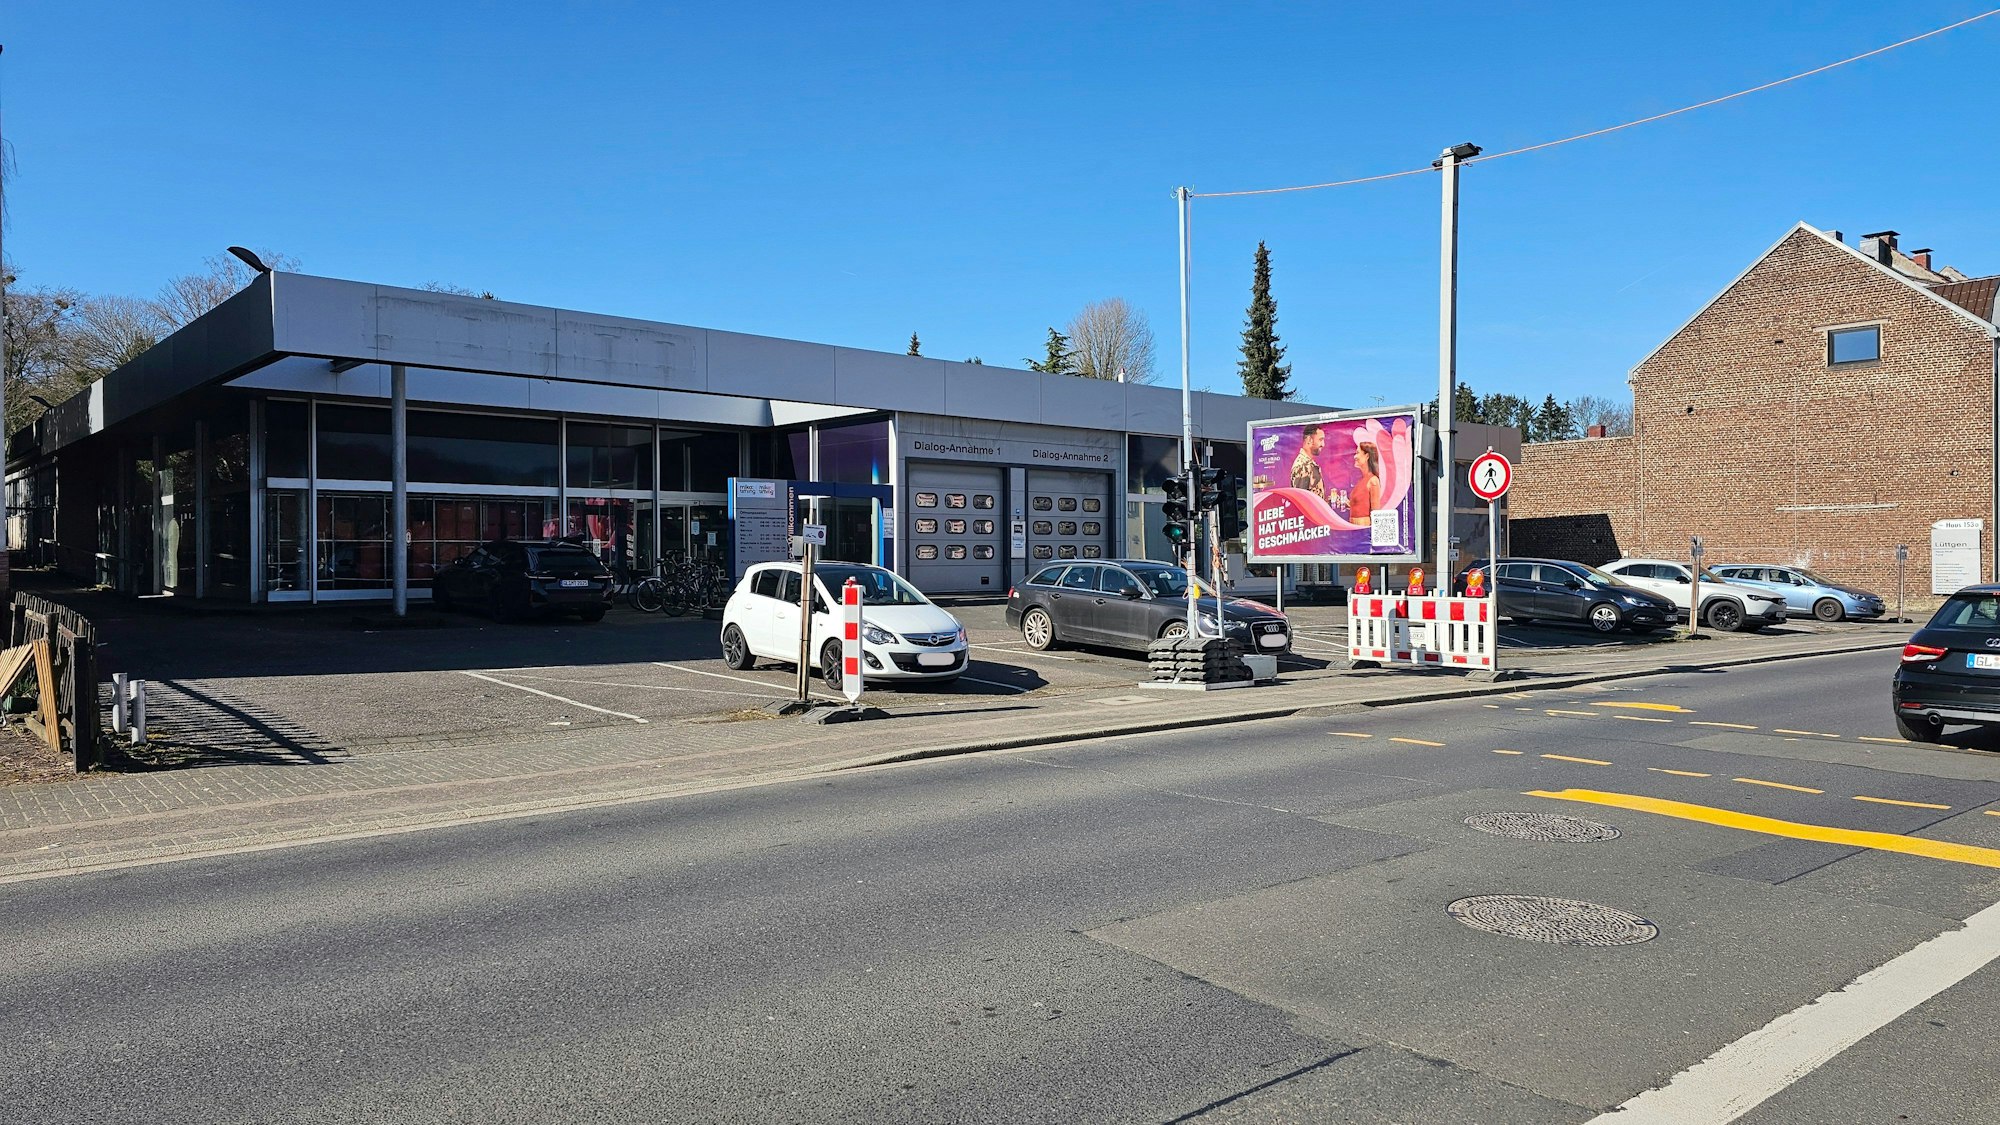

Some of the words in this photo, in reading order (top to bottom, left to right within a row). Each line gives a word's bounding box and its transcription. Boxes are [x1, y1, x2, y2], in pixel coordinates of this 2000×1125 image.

[914, 440, 994, 455] Dialog-Annahme
[996, 447, 1001, 456] 1
[1032, 449, 1102, 462] Dialog-Annahme
[1103, 454, 1109, 463] 2
[1258, 505, 1285, 523] LIEBE
[1258, 521, 1278, 536] HAT
[1278, 515, 1305, 532] VIELE
[1258, 524, 1331, 550] GESCHMÄCKER
[1976, 656, 1992, 667] GL
